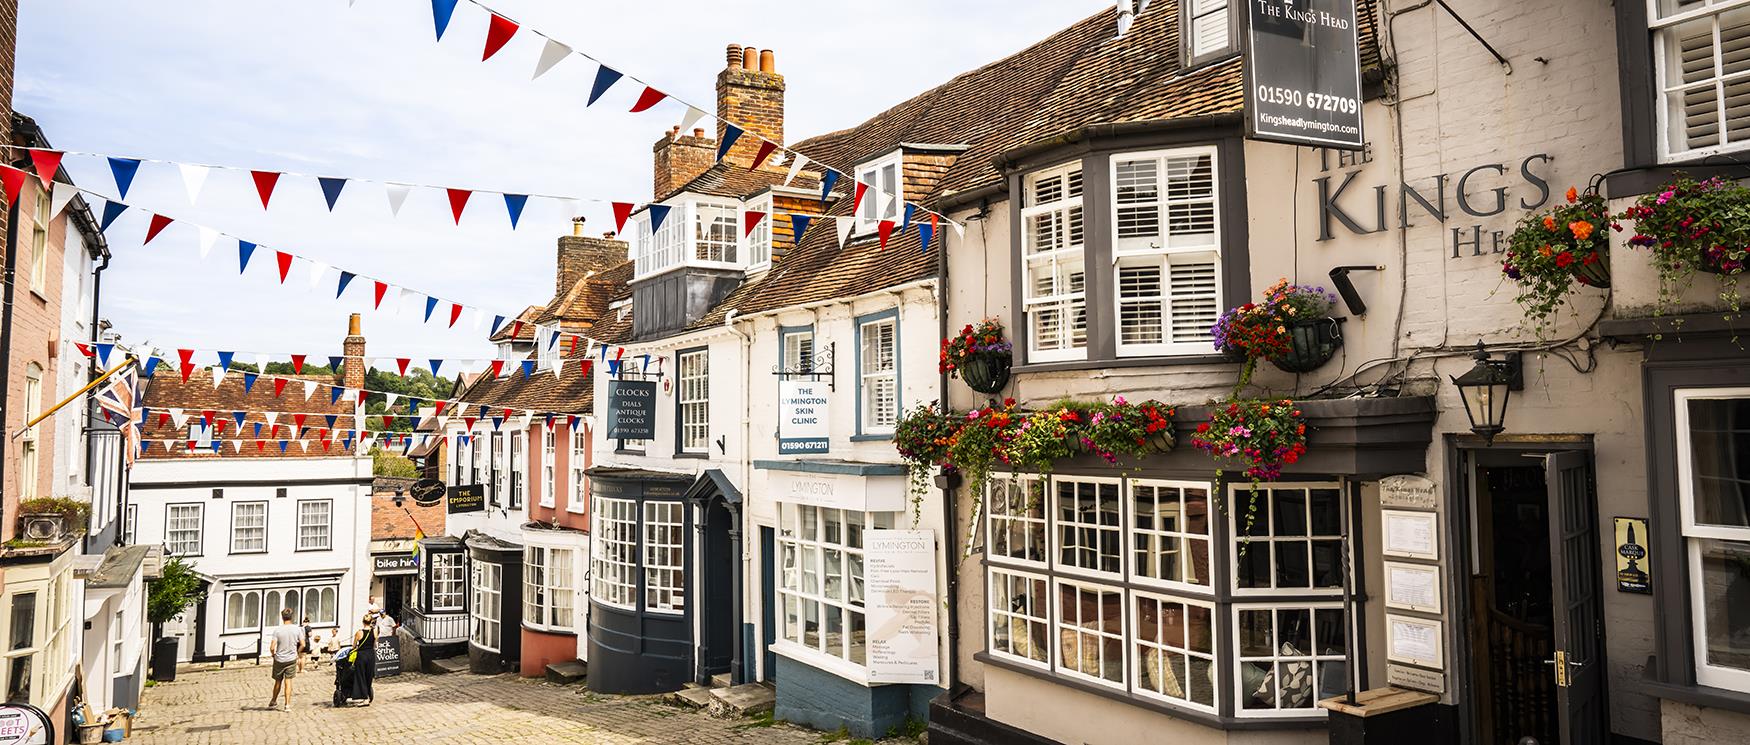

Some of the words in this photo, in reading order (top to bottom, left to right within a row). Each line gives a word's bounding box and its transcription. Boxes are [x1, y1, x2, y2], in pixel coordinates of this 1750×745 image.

[1258, 84, 1302, 107] 01590
[1306, 92, 1357, 114] 672709
[1260, 112, 1358, 134] Kingsheadlymington.com
[1312, 153, 1551, 242] KINGS
[1450, 224, 1506, 258] HE
[615, 388, 650, 397] CLOCKS
[615, 409, 646, 417] ANTIQUE
[792, 417, 818, 425] CLINIC
[781, 441, 804, 450] 01590
[805, 441, 828, 449] 671211
[792, 481, 834, 496] LYMINGTON
[449, 496, 483, 504] EMPORIUM
[872, 541, 925, 550] LYMINGTON
[377, 559, 398, 568] bike
[375, 640, 391, 650] Jack
[377, 653, 399, 661] Wolfe
